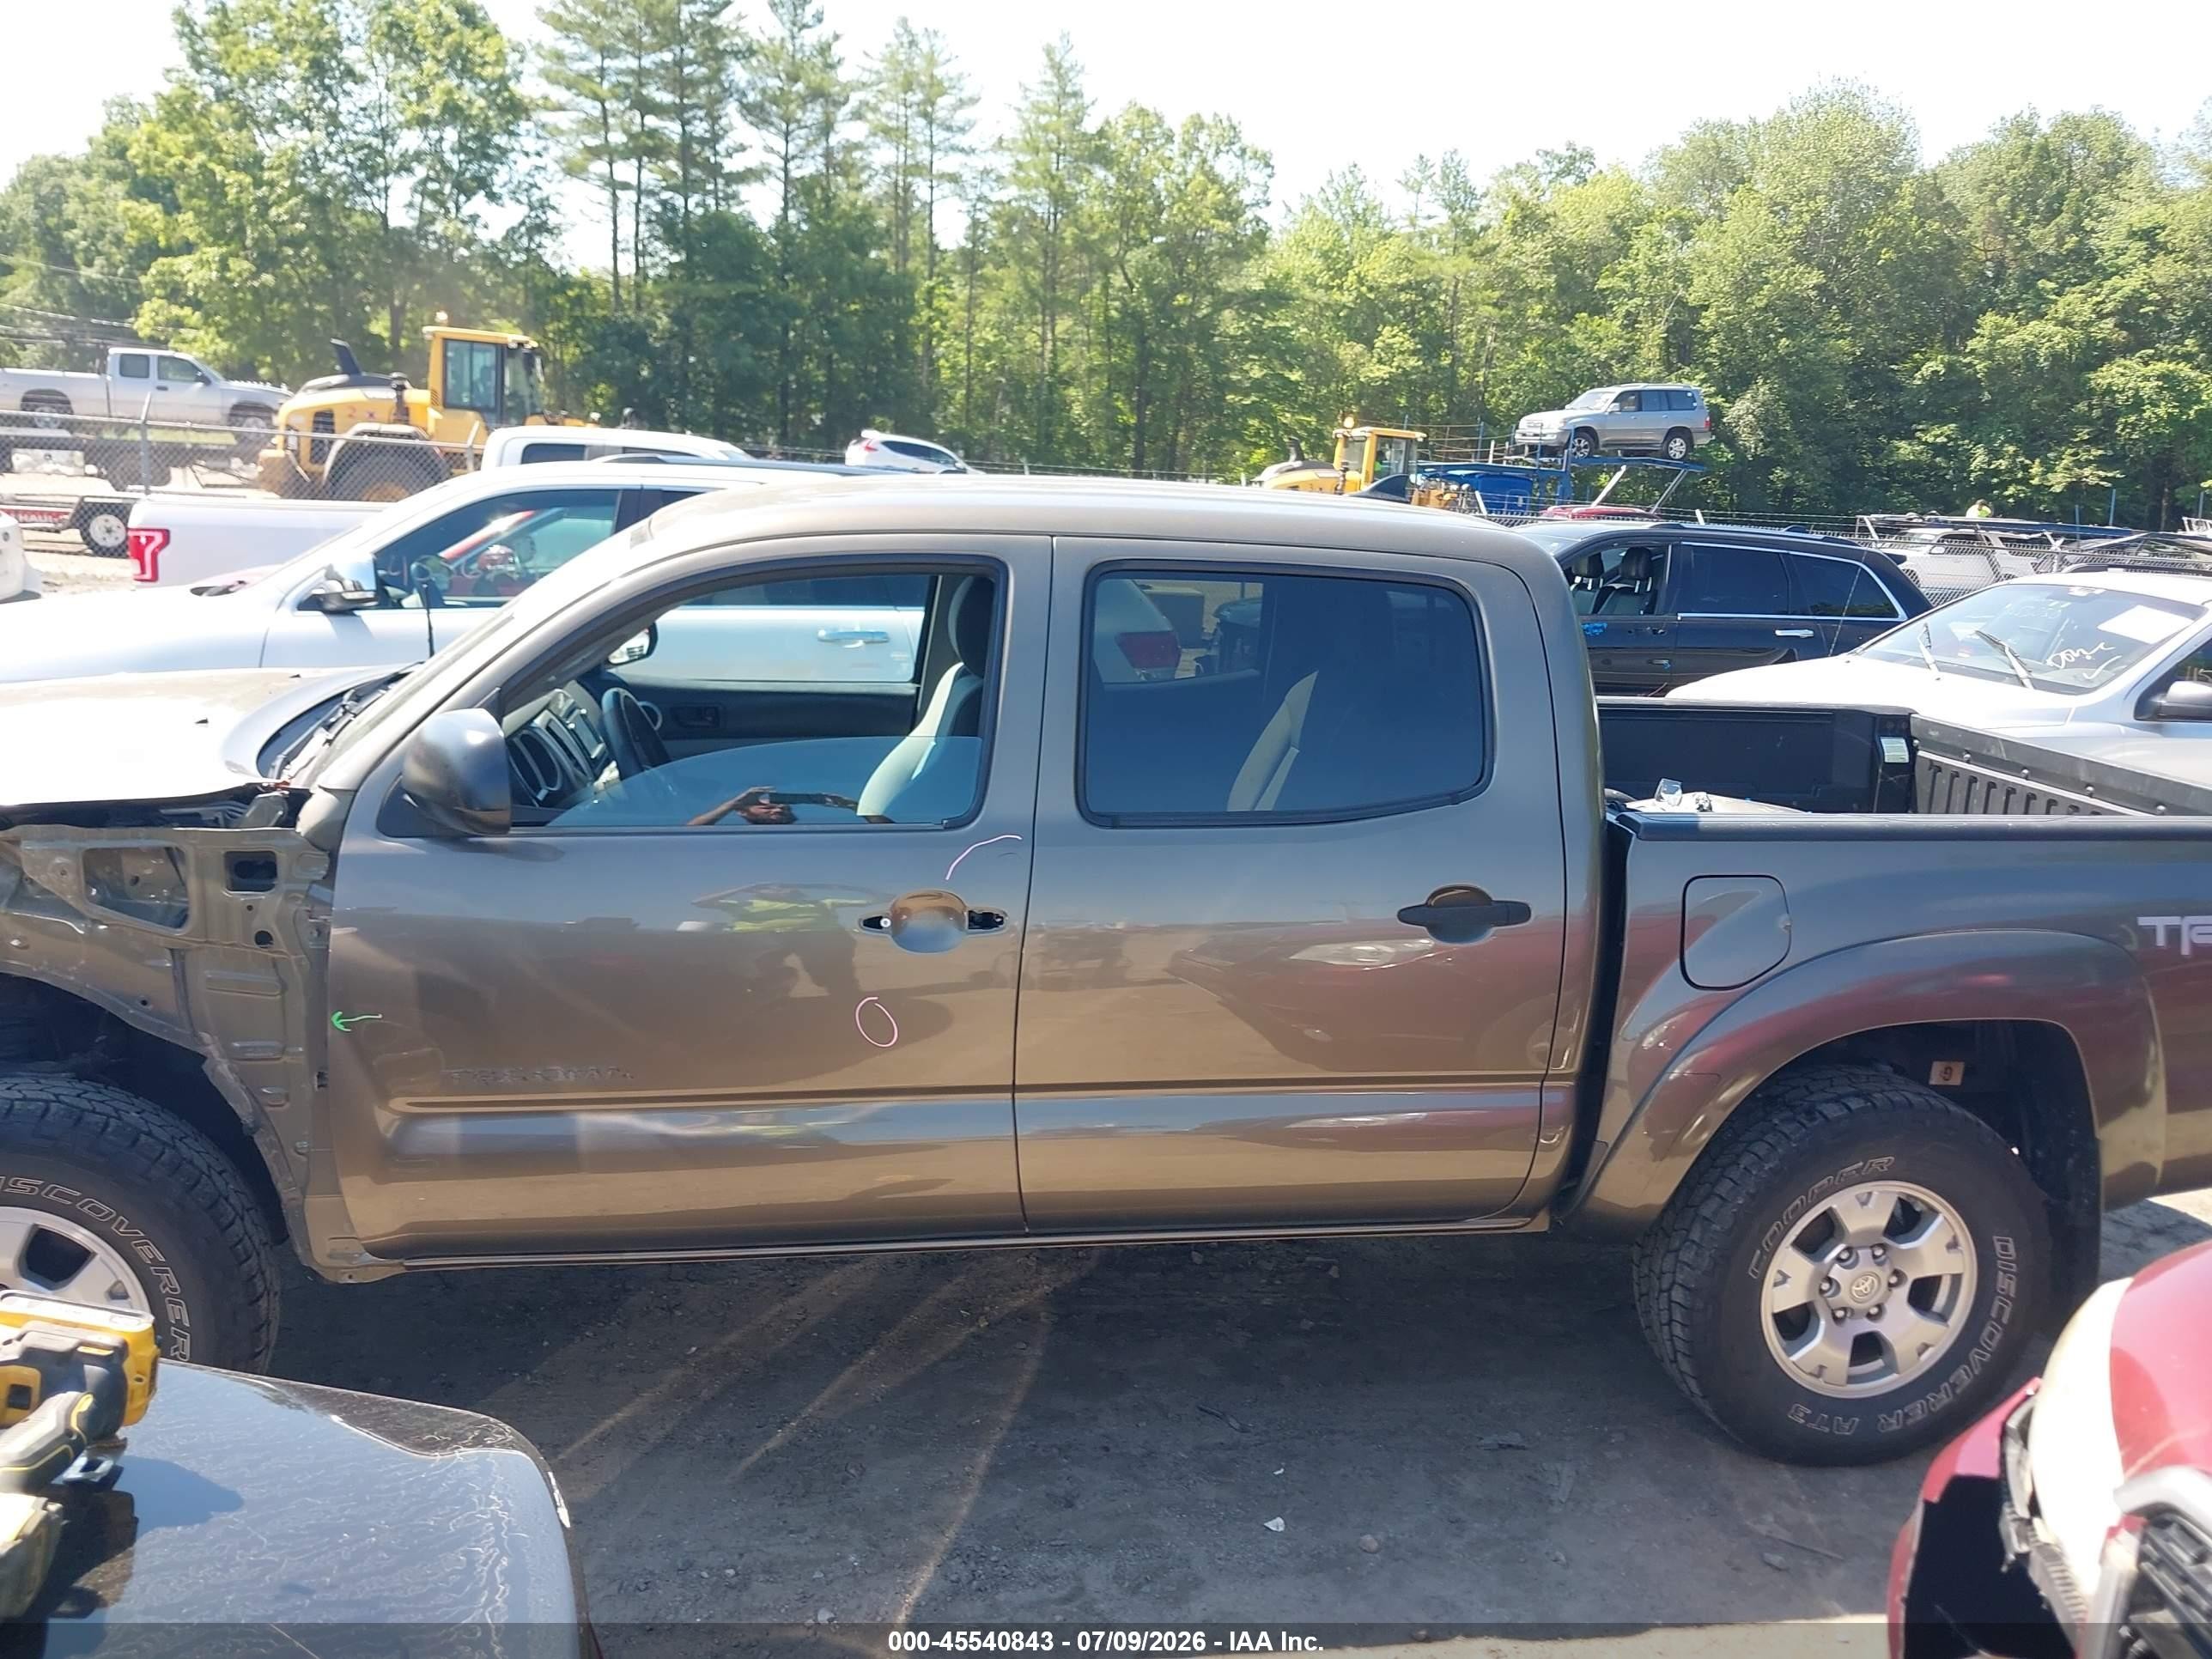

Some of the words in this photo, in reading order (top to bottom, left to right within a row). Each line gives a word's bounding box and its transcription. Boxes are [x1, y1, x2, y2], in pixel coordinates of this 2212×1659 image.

[2136, 915, 2212, 956] TR
[1748, 1156, 1895, 1279] COOPER
[1877, 1236, 2017, 1433] DISCOVERER
[1788, 1403, 1859, 1434] AT3
